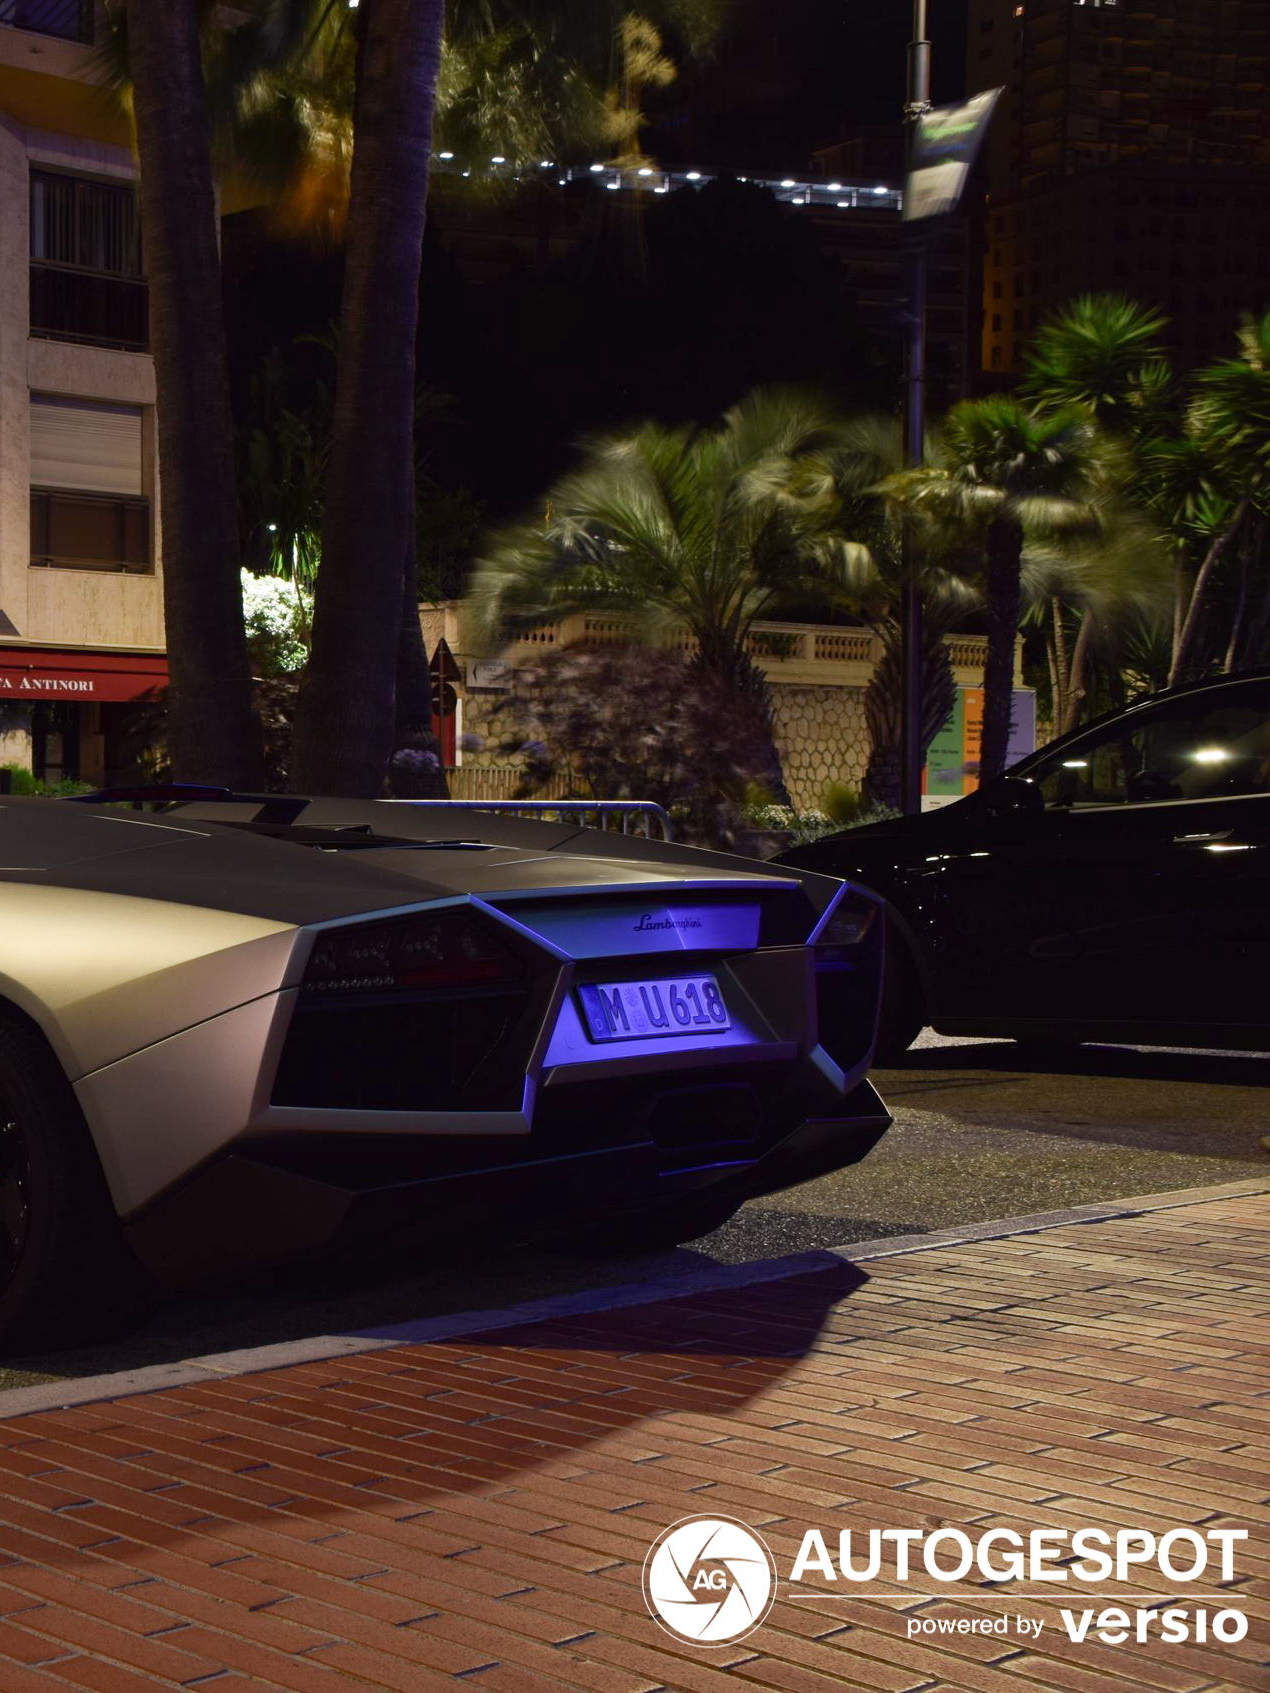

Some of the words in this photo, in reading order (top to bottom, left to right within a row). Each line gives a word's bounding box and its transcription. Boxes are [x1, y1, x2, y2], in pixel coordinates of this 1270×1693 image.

[20, 677, 94, 691] ANTINORI
[633, 914, 702, 931] Lamborghini
[599, 987, 631, 1031] M
[638, 981, 727, 1028] U618
